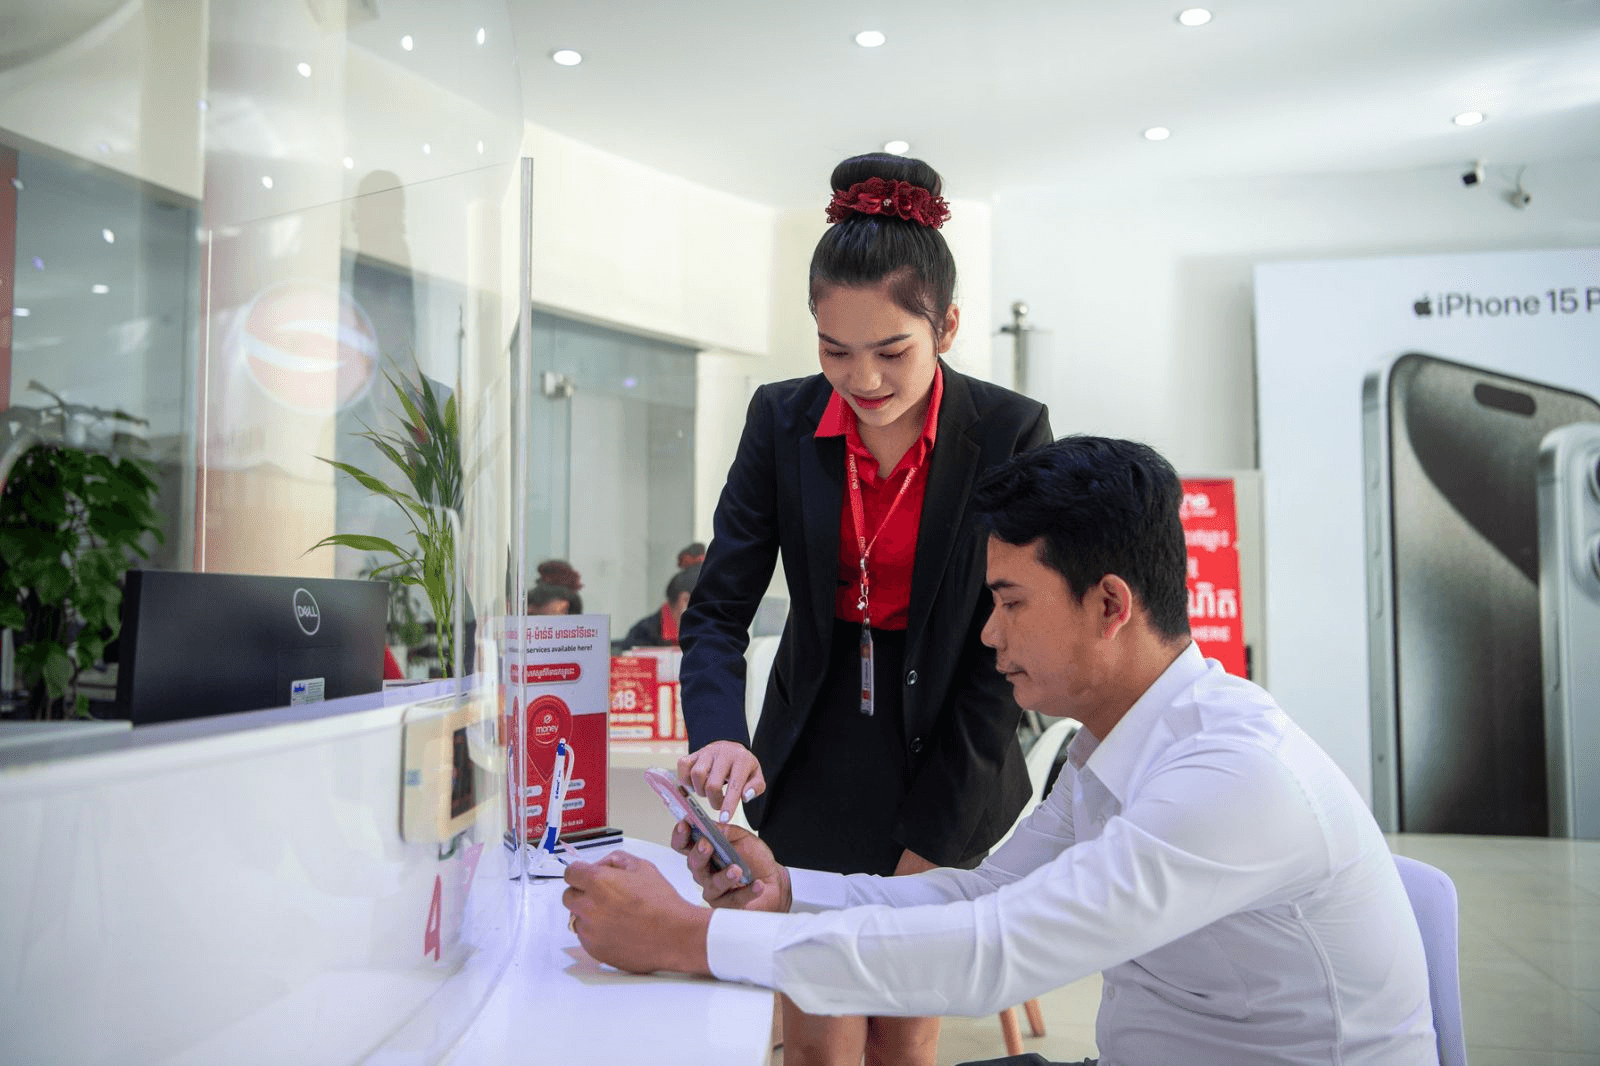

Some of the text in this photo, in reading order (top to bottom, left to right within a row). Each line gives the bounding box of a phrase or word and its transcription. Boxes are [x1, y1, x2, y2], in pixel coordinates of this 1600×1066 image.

[1438, 292, 1541, 317] iPhone
[1546, 287, 1579, 314] 15
[297, 605, 318, 618] DELL
[526, 646, 551, 654] services
[577, 643, 593, 651] here!
[536, 725, 558, 735] money
